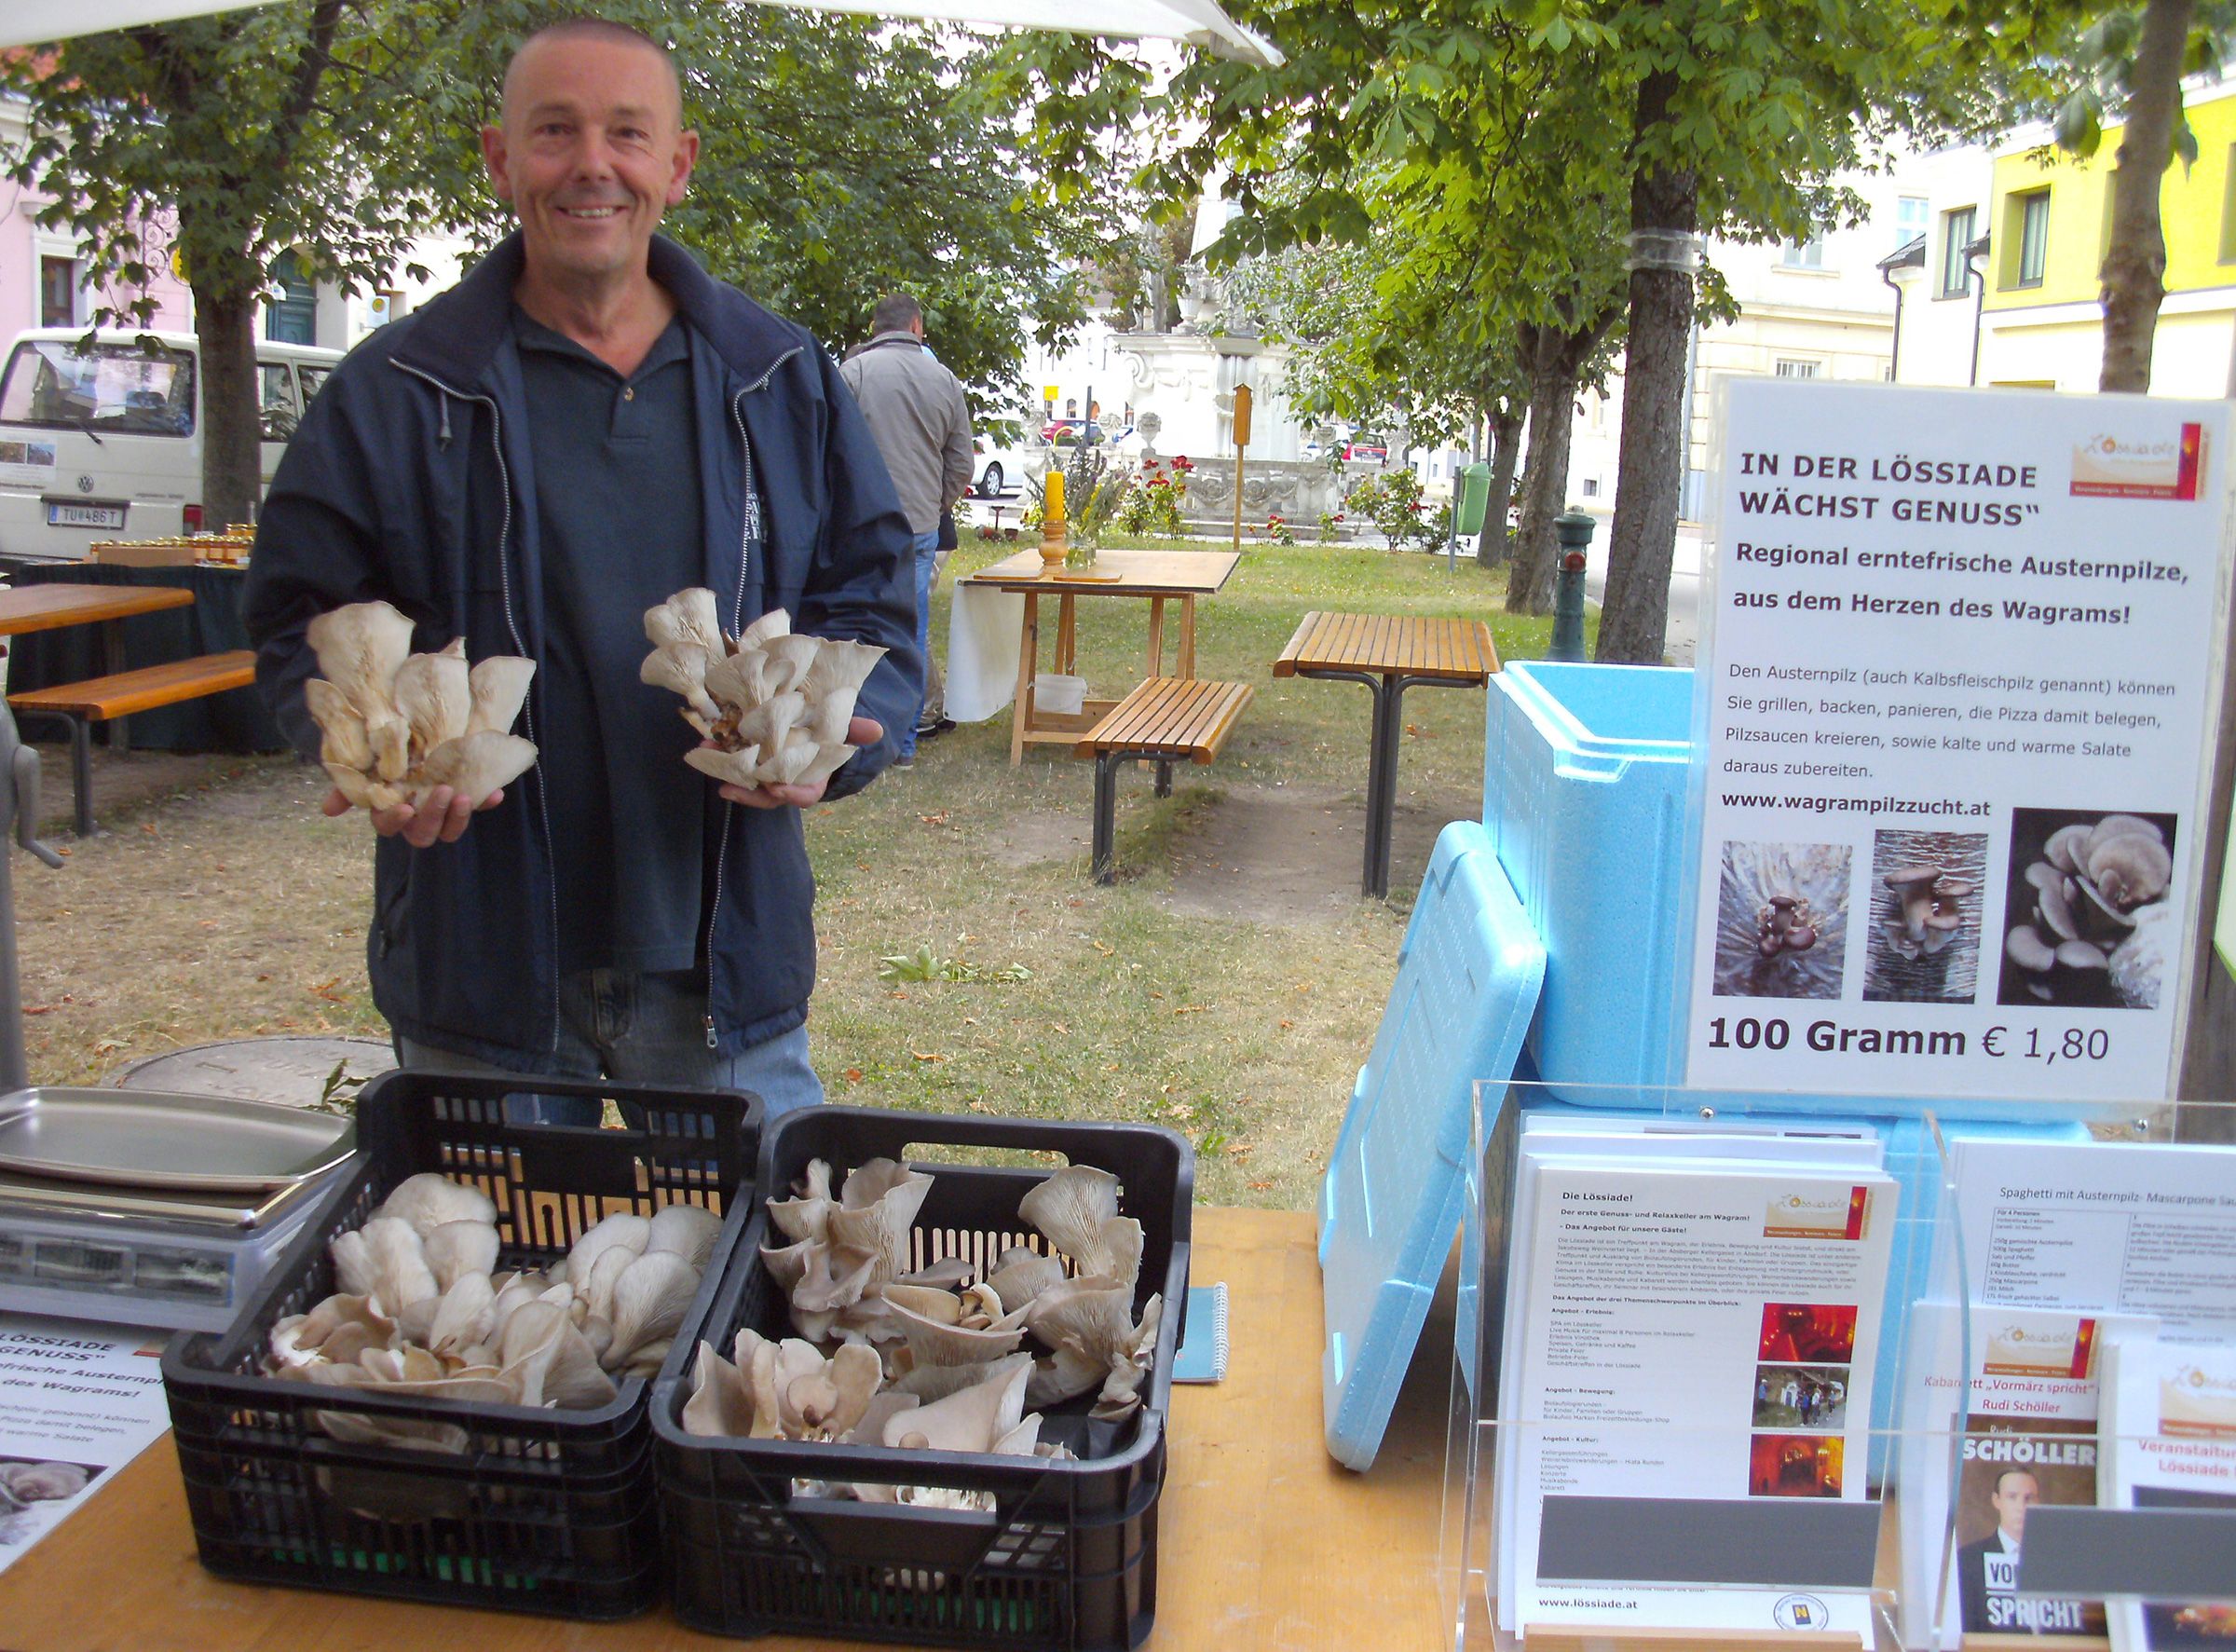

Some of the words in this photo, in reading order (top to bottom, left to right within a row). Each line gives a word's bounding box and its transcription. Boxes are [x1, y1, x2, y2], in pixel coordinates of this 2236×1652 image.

[1740, 452, 1778, 475] IN
[1793, 455, 1857, 480] DER
[1872, 454, 2036, 488] LÖSSIADE
[1738, 486, 1879, 519] WÄCHST
[1736, 541, 1847, 567] Regional
[1857, 550, 2011, 573] erntefrische
[2020, 555, 2187, 584] Austernpilze,
[1733, 591, 1778, 609] aus
[1786, 589, 1841, 610] dem
[1851, 593, 1940, 615] Herzen
[1949, 597, 1992, 618] des
[2002, 600, 2130, 625] Wagrams!
[1729, 662, 1761, 679] Den
[1766, 662, 1856, 686] Austernpilz
[1862, 668, 1906, 686] (auch
[1914, 671, 2033, 691] Kalbsfleischpilz
[2039, 678, 2110, 696] genannt)
[2118, 679, 2175, 695] können
[1727, 695, 1754, 710] Sie
[1757, 694, 1812, 716] grillen,
[1820, 696, 1880, 717] backen,
[1888, 703, 1961, 721] panieren,
[1969, 704, 1992, 719] die
[1998, 706, 2037, 722] Pizza
[2043, 707, 2088, 724] damit
[2094, 710, 2160, 729] belegen,
[1725, 727, 1808, 744] Pilzsaucen
[1814, 730, 1884, 749] kreieren,
[1891, 735, 1936, 749] sowie
[1942, 735, 1981, 751] kalte
[1986, 738, 2015, 752] und
[2022, 742, 2075, 754] warme
[2081, 741, 2131, 757] Salate
[1723, 759, 1778, 774] daraus
[1783, 759, 1872, 777] zubereiten.
[1722, 793, 1990, 815] www.wagrampilzzucht.at
[1708, 1017, 1790, 1050] 100
[1806, 1019, 1965, 1055] Gramm
[1982, 1025, 2007, 1057] €
[2025, 1027, 2108, 1065] 1,80
[1583, 1193, 1633, 1202] Lössiade!
[2000, 1187, 2052, 1200] Spaghetti
[2055, 1190, 2073, 1198] mit
[2147, 1193, 2216, 1206] Mascarpone
[1582, 1224, 1616, 1233] Angebot
[1713, 1214, 1750, 1223] Wagram!
[43, 1382, 140, 1398] Wagrams!
[1983, 1399, 2009, 1411] Rudi
[2012, 1399, 2061, 1413] Schöller
[1964, 1437, 2096, 1465] SCHÖLLER
[1539, 1599, 1638, 1609] www.lössiade.at
[1986, 1597, 2081, 1629] SPRICHT
